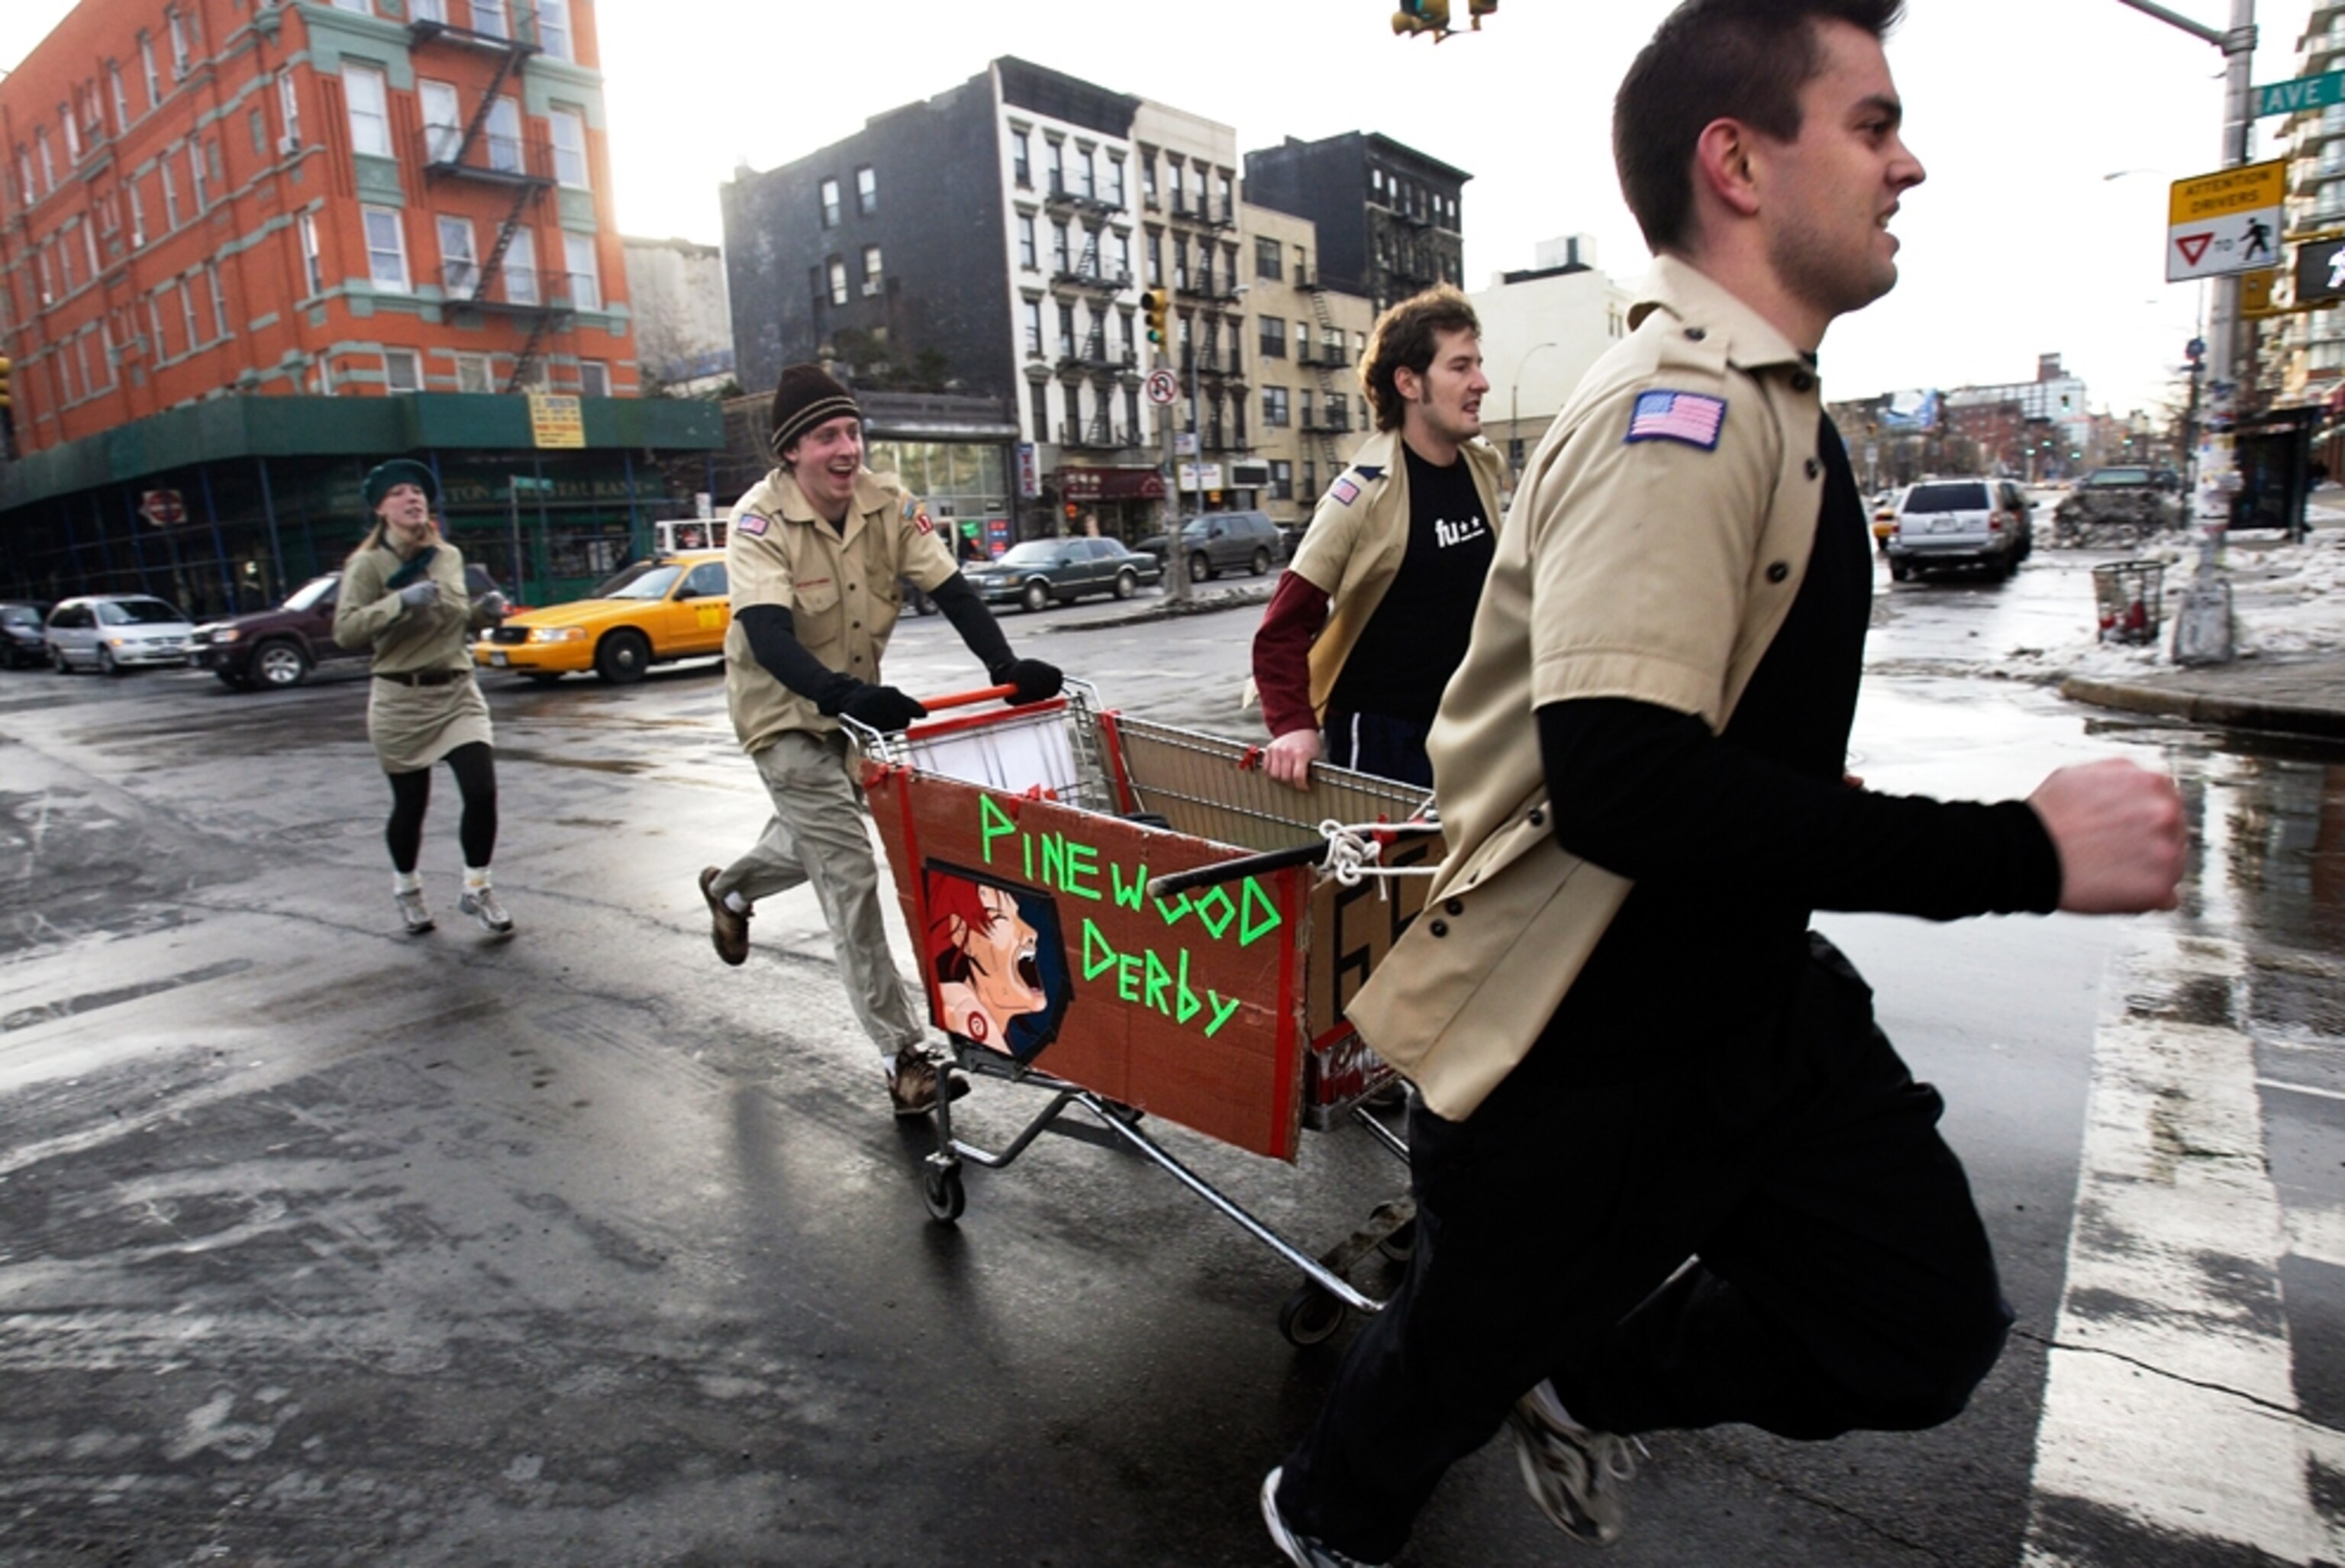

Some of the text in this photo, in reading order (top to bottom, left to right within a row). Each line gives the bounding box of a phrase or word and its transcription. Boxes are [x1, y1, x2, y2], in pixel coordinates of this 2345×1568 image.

[2264, 79, 2322, 112] AVE
[2185, 171, 2269, 195] ATTENTION
[2190, 189, 2260, 214] DRIVERS
[1021, 453, 1034, 492] TAX
